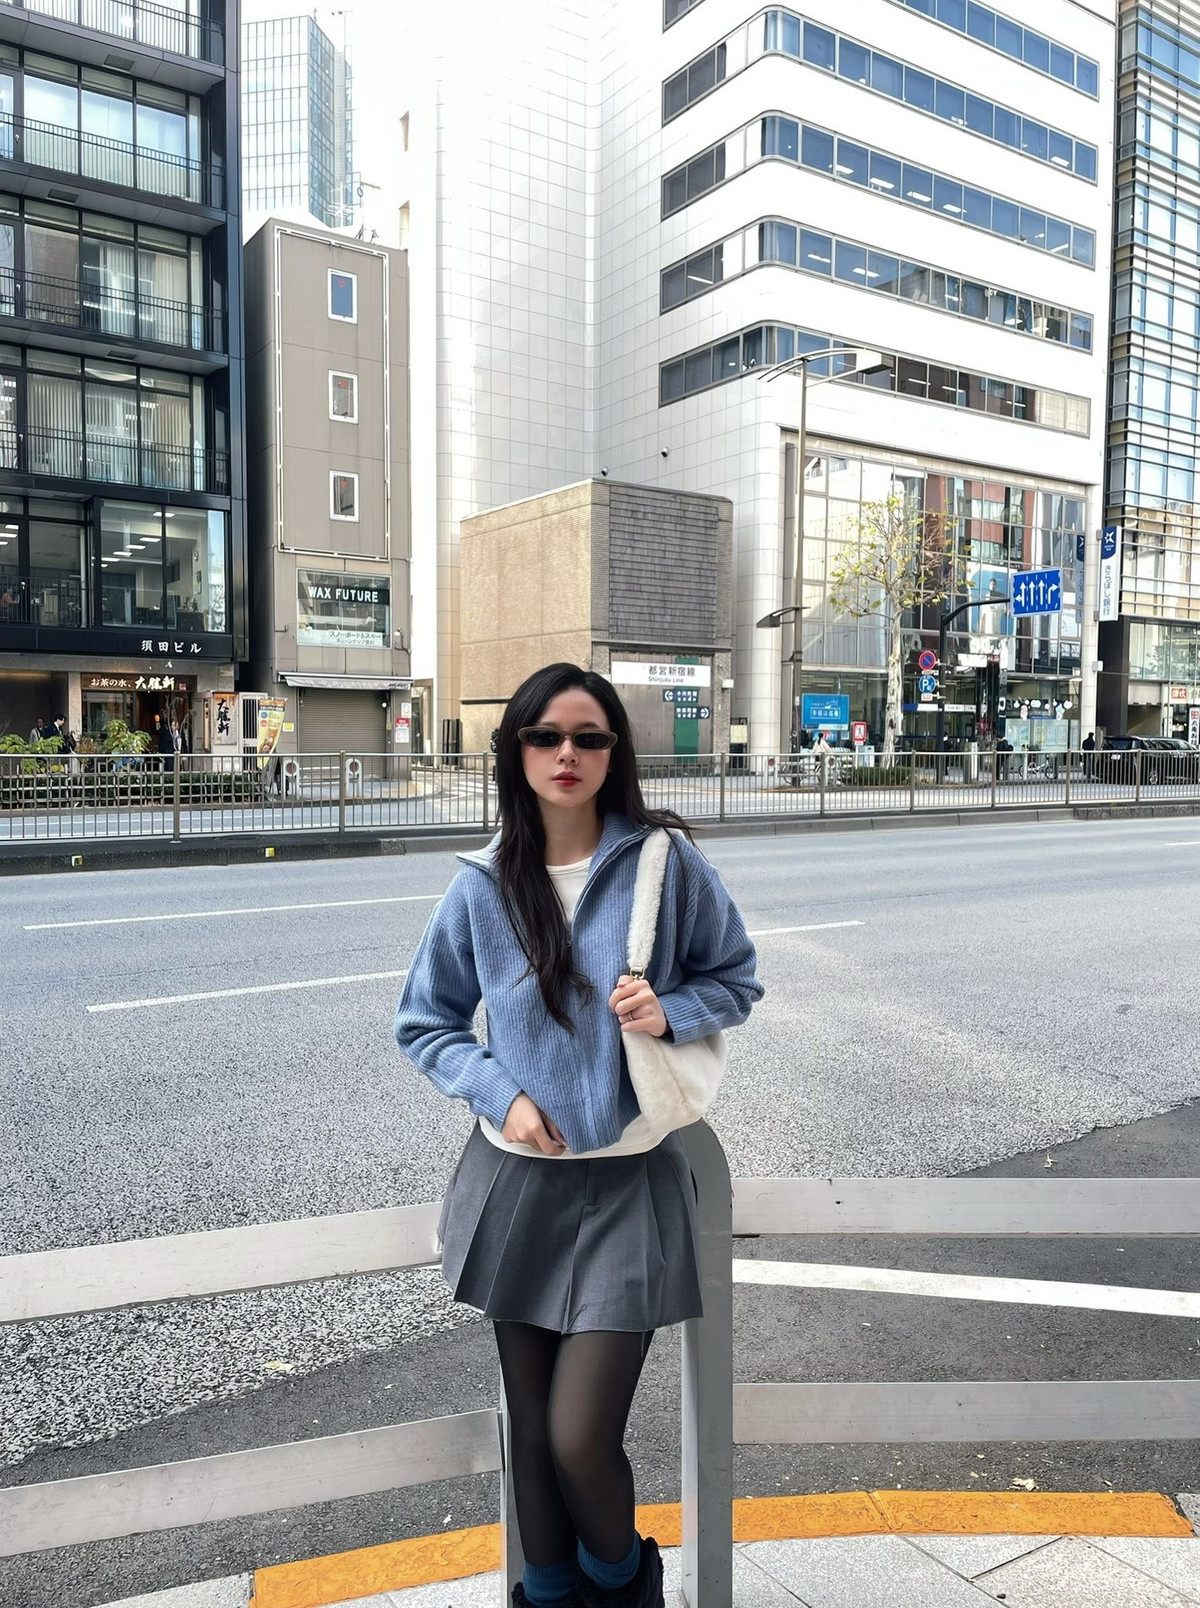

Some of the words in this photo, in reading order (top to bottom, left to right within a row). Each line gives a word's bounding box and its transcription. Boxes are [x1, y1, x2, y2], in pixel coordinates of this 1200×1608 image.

[307, 586, 331, 599] WAX
[335, 588, 379, 603] FUTURE
[141, 640, 202, 654] 須田ビル
[648, 665, 696, 677] 都営新宿線
